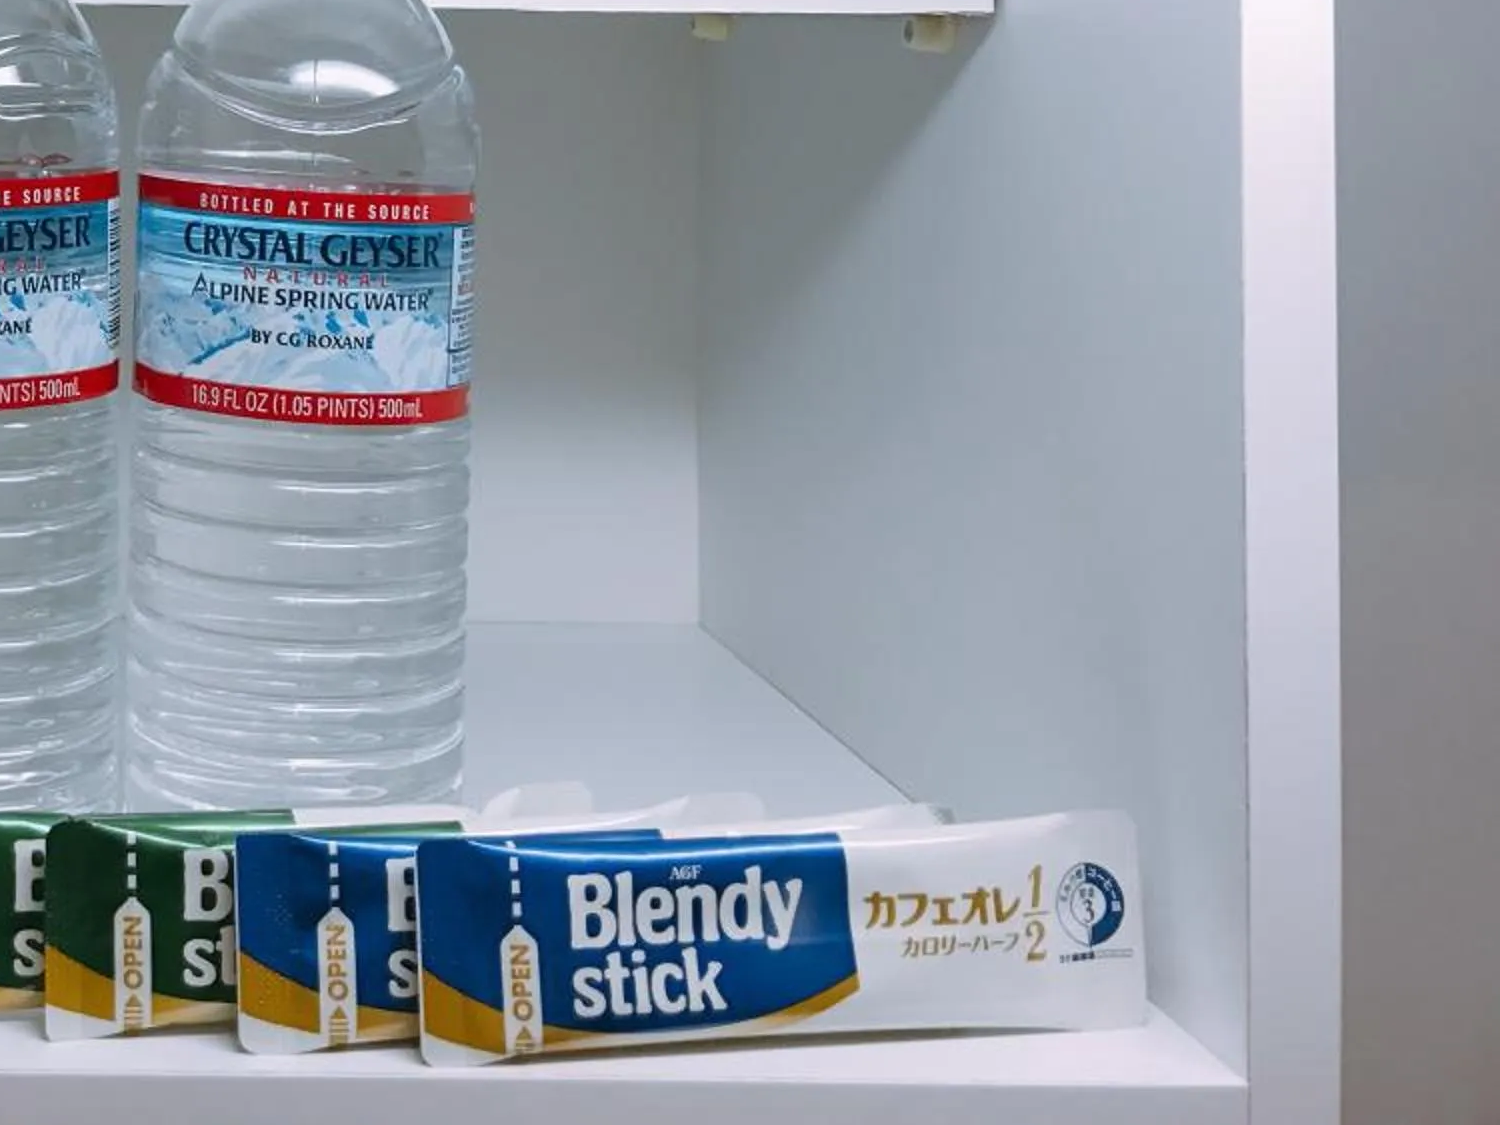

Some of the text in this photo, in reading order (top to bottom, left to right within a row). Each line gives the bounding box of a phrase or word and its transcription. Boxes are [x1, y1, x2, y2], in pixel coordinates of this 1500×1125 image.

[22, 187, 81, 204] SOURCE
[200, 193, 429, 220] BOTTLED AT THE SOURCE
[184, 222, 440, 267] CRYSTAL GEYSER
[21, 273, 82, 293] WATER
[191, 273, 428, 311] ALPINE SPRING WATER
[252, 329, 272, 345] BY
[278, 332, 301, 347] CG
[39, 377, 81, 399] 500mL
[192, 384, 423, 418] 16.9 FL OZ (1.05 PINTS) 500mL
[669, 864, 702, 880] AGF
[567, 864, 803, 950] Blendy
[863, 886, 1021, 929] カフェオレ
[124, 915, 145, 989] OPEN
[328, 924, 350, 1001] OPEN
[901, 933, 1019, 958] カロリーハーフ
[512, 944, 533, 1022] OPEN
[572, 946, 728, 1018] stick
